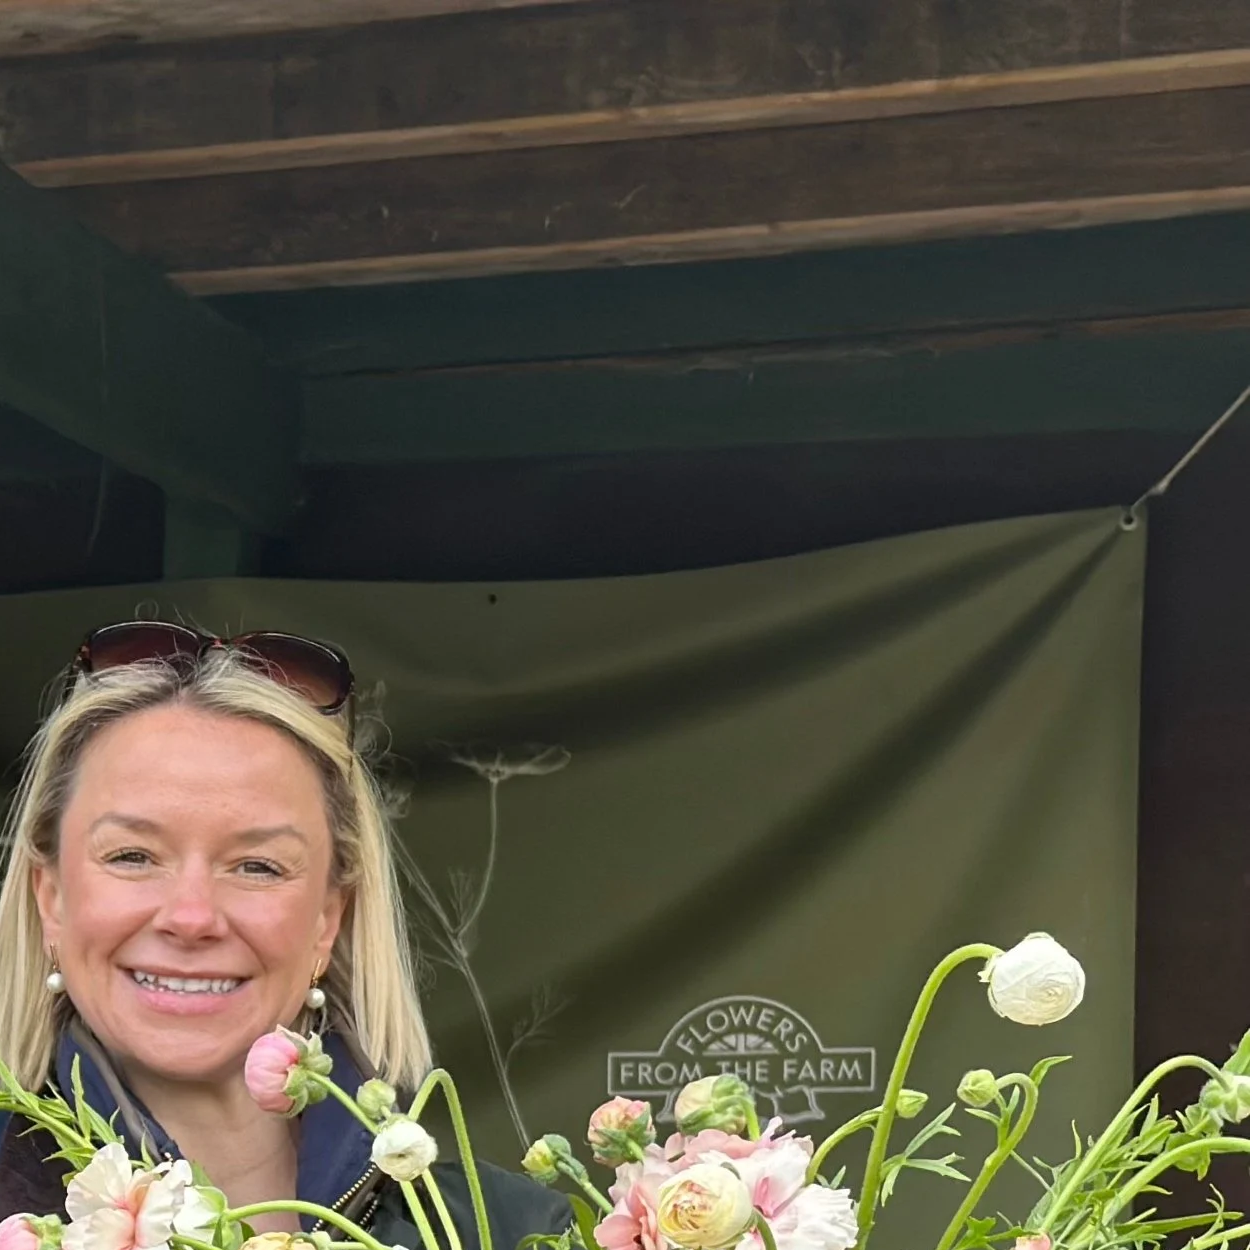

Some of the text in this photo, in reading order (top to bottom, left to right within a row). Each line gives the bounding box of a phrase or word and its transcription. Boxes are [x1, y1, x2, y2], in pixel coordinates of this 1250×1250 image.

[676, 1005, 808, 1056] FLOWERS
[620, 1059, 863, 1085] FROM THE FARM
